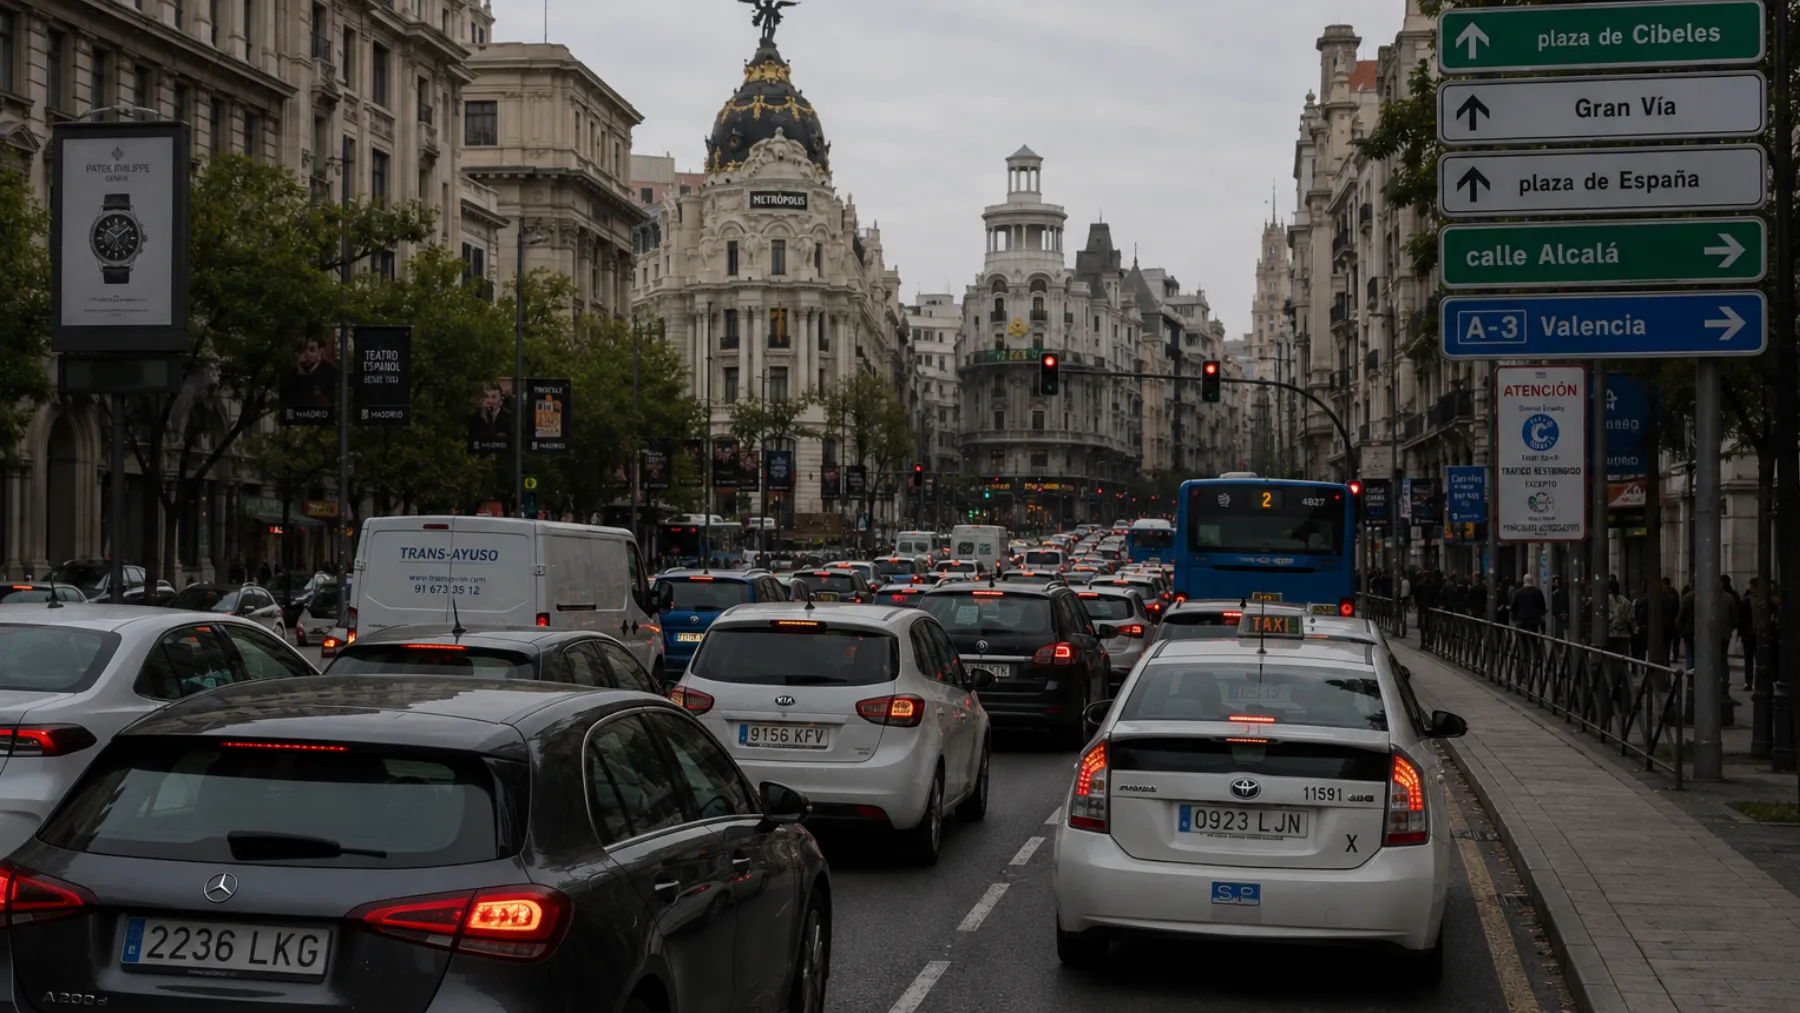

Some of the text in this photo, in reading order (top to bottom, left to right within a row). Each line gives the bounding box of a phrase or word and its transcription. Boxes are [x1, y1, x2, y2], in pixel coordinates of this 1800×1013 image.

[1538, 23, 1721, 52] plaza de Cibeles
[1575, 95, 1676, 118] Gran Vía
[86, 164, 112, 173] PATEK
[1520, 169, 1700, 197] plaza de España
[753, 192, 806, 206] METRÓPOLIS
[1466, 242, 1620, 267] calle Alcalá
[1465, 313, 1647, 339] A-3 Valencia
[365, 349, 399, 360] TEATRO
[1503, 381, 1577, 398] ATENCIÓN
[1261, 491, 1272, 508] 2
[1301, 498, 1326, 507] 4827
[400, 547, 499, 562] TRANS-AYUSO
[430, 584, 448, 595] 673
[452, 585, 465, 595] 35
[468, 585, 480, 595] 12
[1252, 616, 1289, 633] TAXI
[776, 696, 794, 705] KIA
[751, 727, 824, 744] 9156 KFV
[1303, 786, 1343, 802] 11591
[1194, 809, 1301, 834] 0923 LJN
[1345, 834, 1359, 853] X
[146, 924, 320, 968] 2236 LKG
